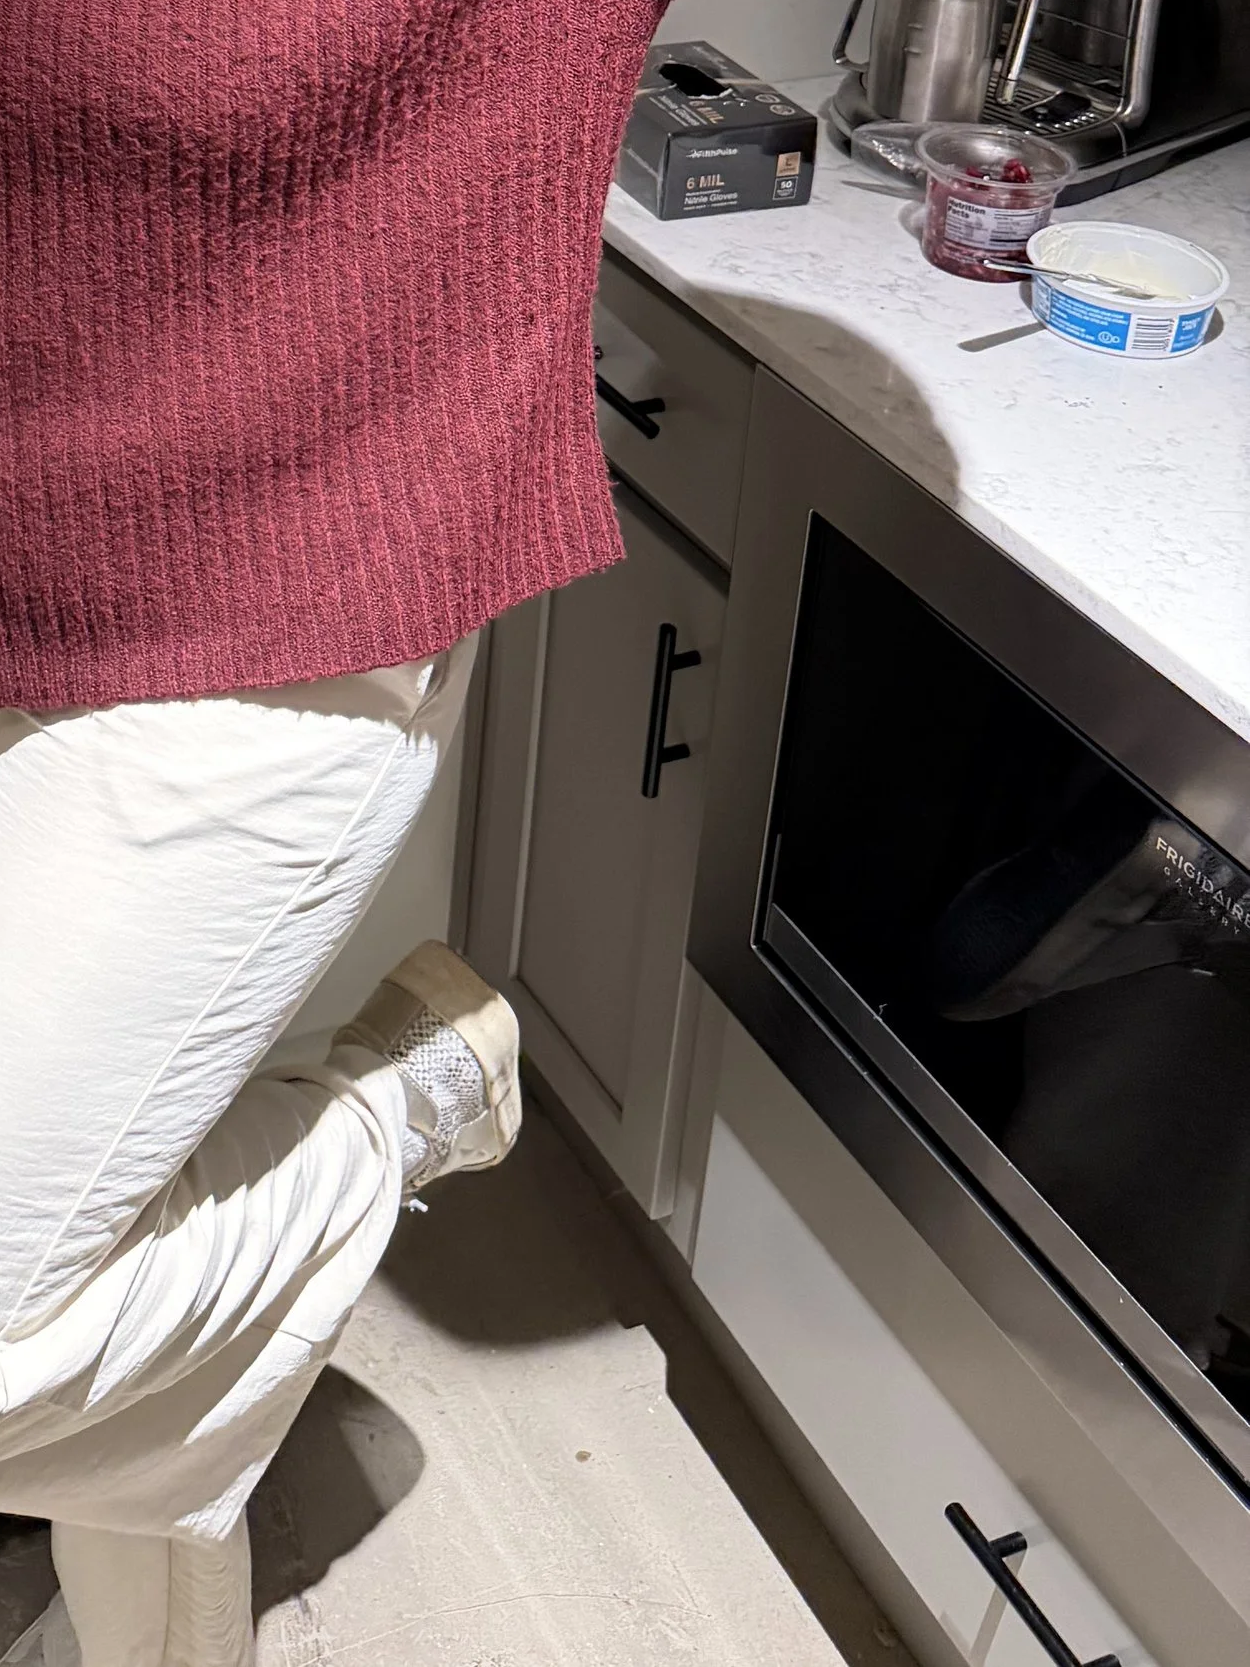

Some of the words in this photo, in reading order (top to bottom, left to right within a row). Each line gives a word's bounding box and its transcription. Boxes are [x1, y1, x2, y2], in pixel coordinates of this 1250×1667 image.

[686, 177, 695, 190] 6
[699, 174, 725, 188] MIL
[709, 192, 738, 202] Gloves
[947, 205, 970, 219] Facts
[948, 199, 986, 215] Nutrition
